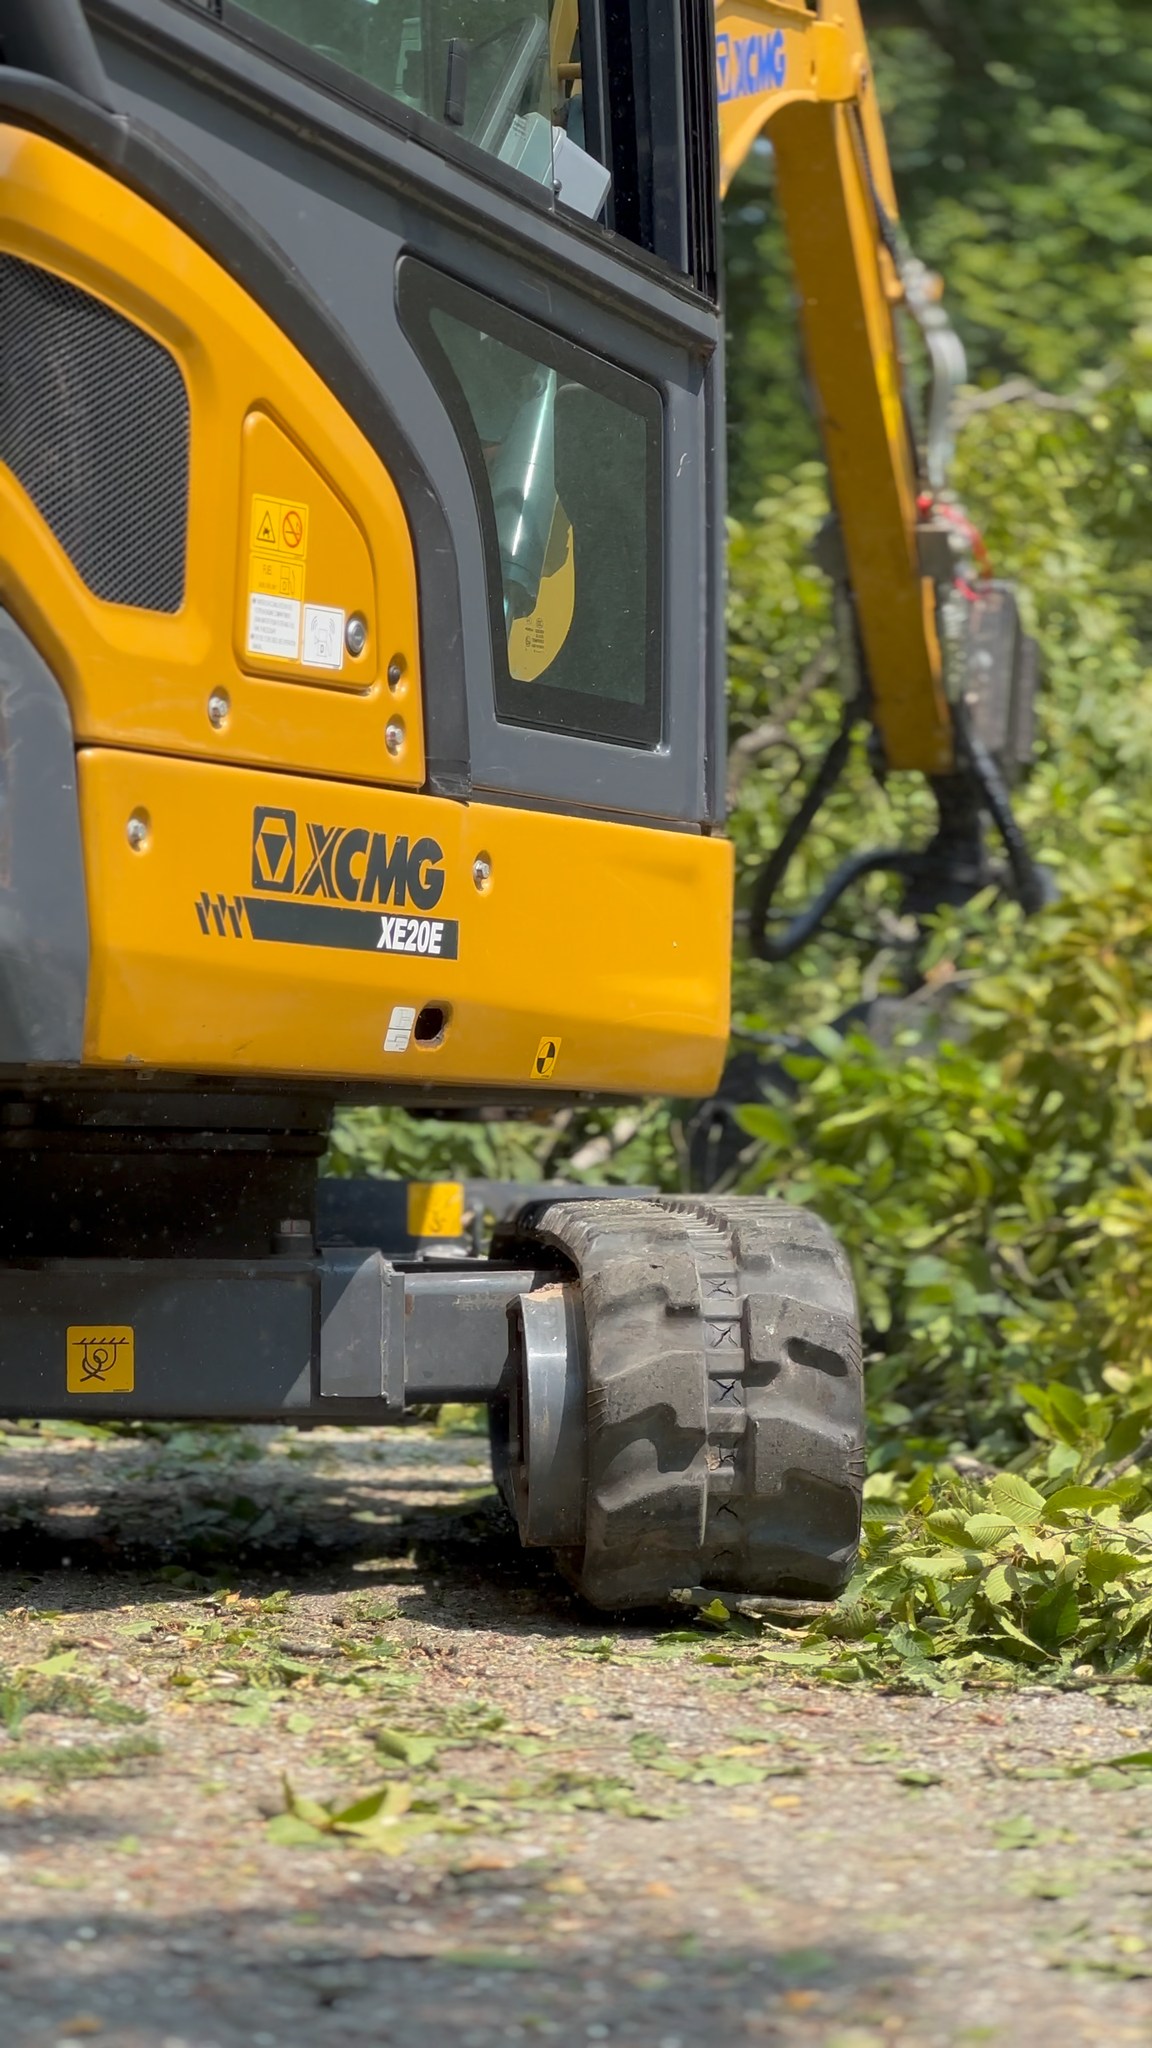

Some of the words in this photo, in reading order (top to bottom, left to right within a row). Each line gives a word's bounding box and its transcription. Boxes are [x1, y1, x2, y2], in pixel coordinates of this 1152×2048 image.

[733, 28, 786, 98] XCMG
[294, 823, 445, 911] XCMG
[377, 916, 445, 955] XE20E
